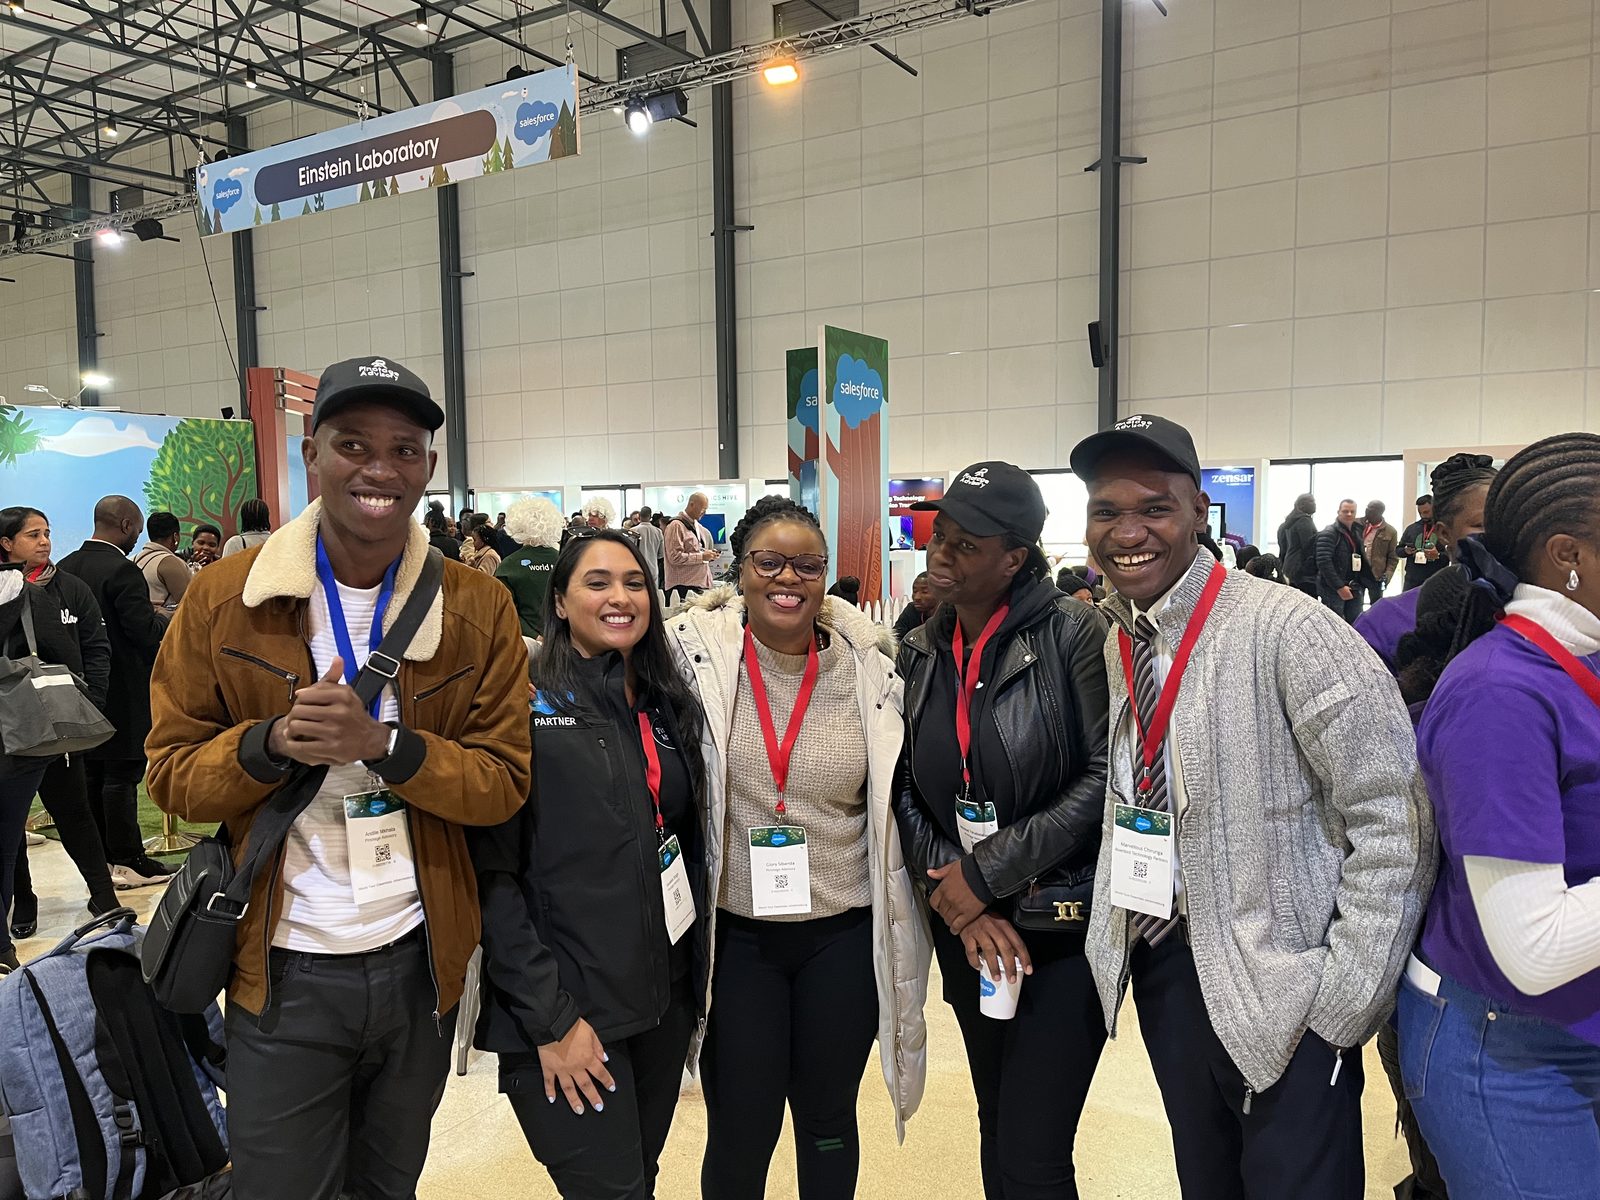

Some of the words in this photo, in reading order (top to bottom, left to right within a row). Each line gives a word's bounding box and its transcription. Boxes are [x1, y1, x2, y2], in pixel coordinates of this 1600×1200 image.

[519, 112, 555, 128] salesforce
[298, 157, 352, 187] Einstein
[355, 137, 440, 173] Laboratory
[215, 188, 240, 200] salesforce
[840, 379, 880, 401] salesforce
[1211, 474, 1254, 483] zensar
[893, 494, 926, 503] Technology
[529, 563, 550, 571] world
[534, 716, 577, 727] PARTNER
